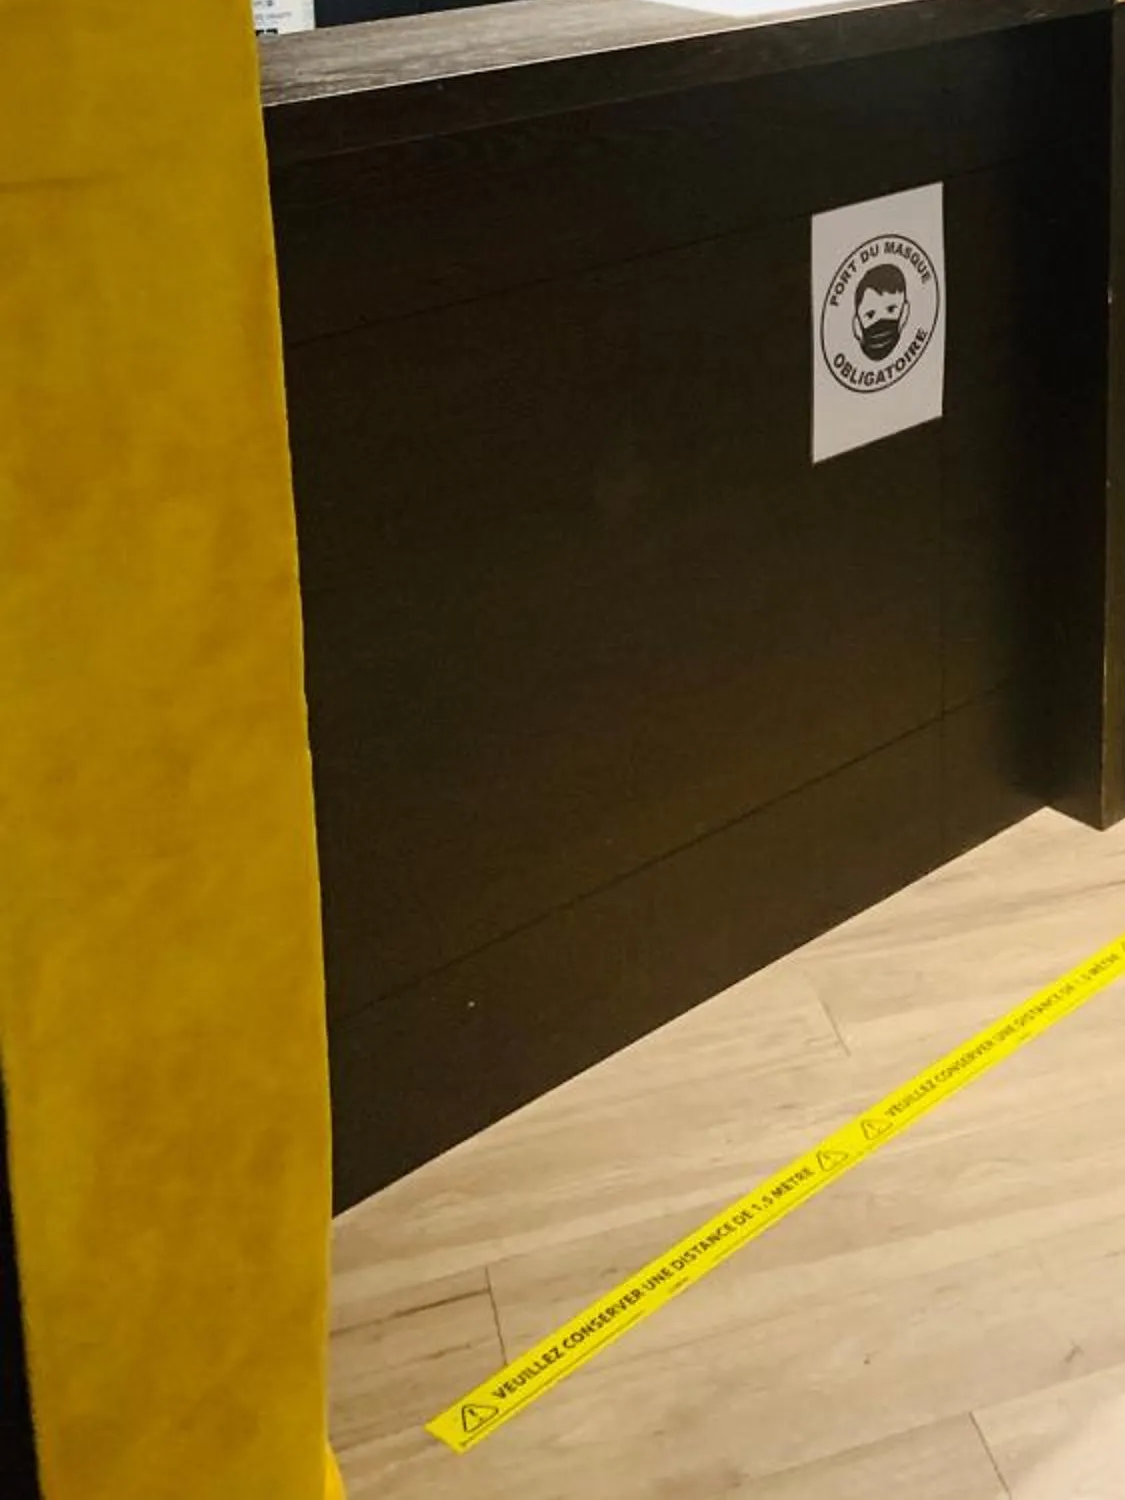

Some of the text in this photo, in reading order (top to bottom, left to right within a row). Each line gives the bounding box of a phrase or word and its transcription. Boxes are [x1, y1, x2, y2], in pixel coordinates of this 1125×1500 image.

[829, 241, 931, 307] PORT DU MASQUE
[833, 327, 928, 386] OBLIGATOIRE
[491, 1347, 565, 1399] VEUILLEZ
[562, 1288, 645, 1350] CONSERVER
[642, 1267, 674, 1292] UNE
[671, 1222, 738, 1272] DISTANCE
[731, 1209, 754, 1227] DE
